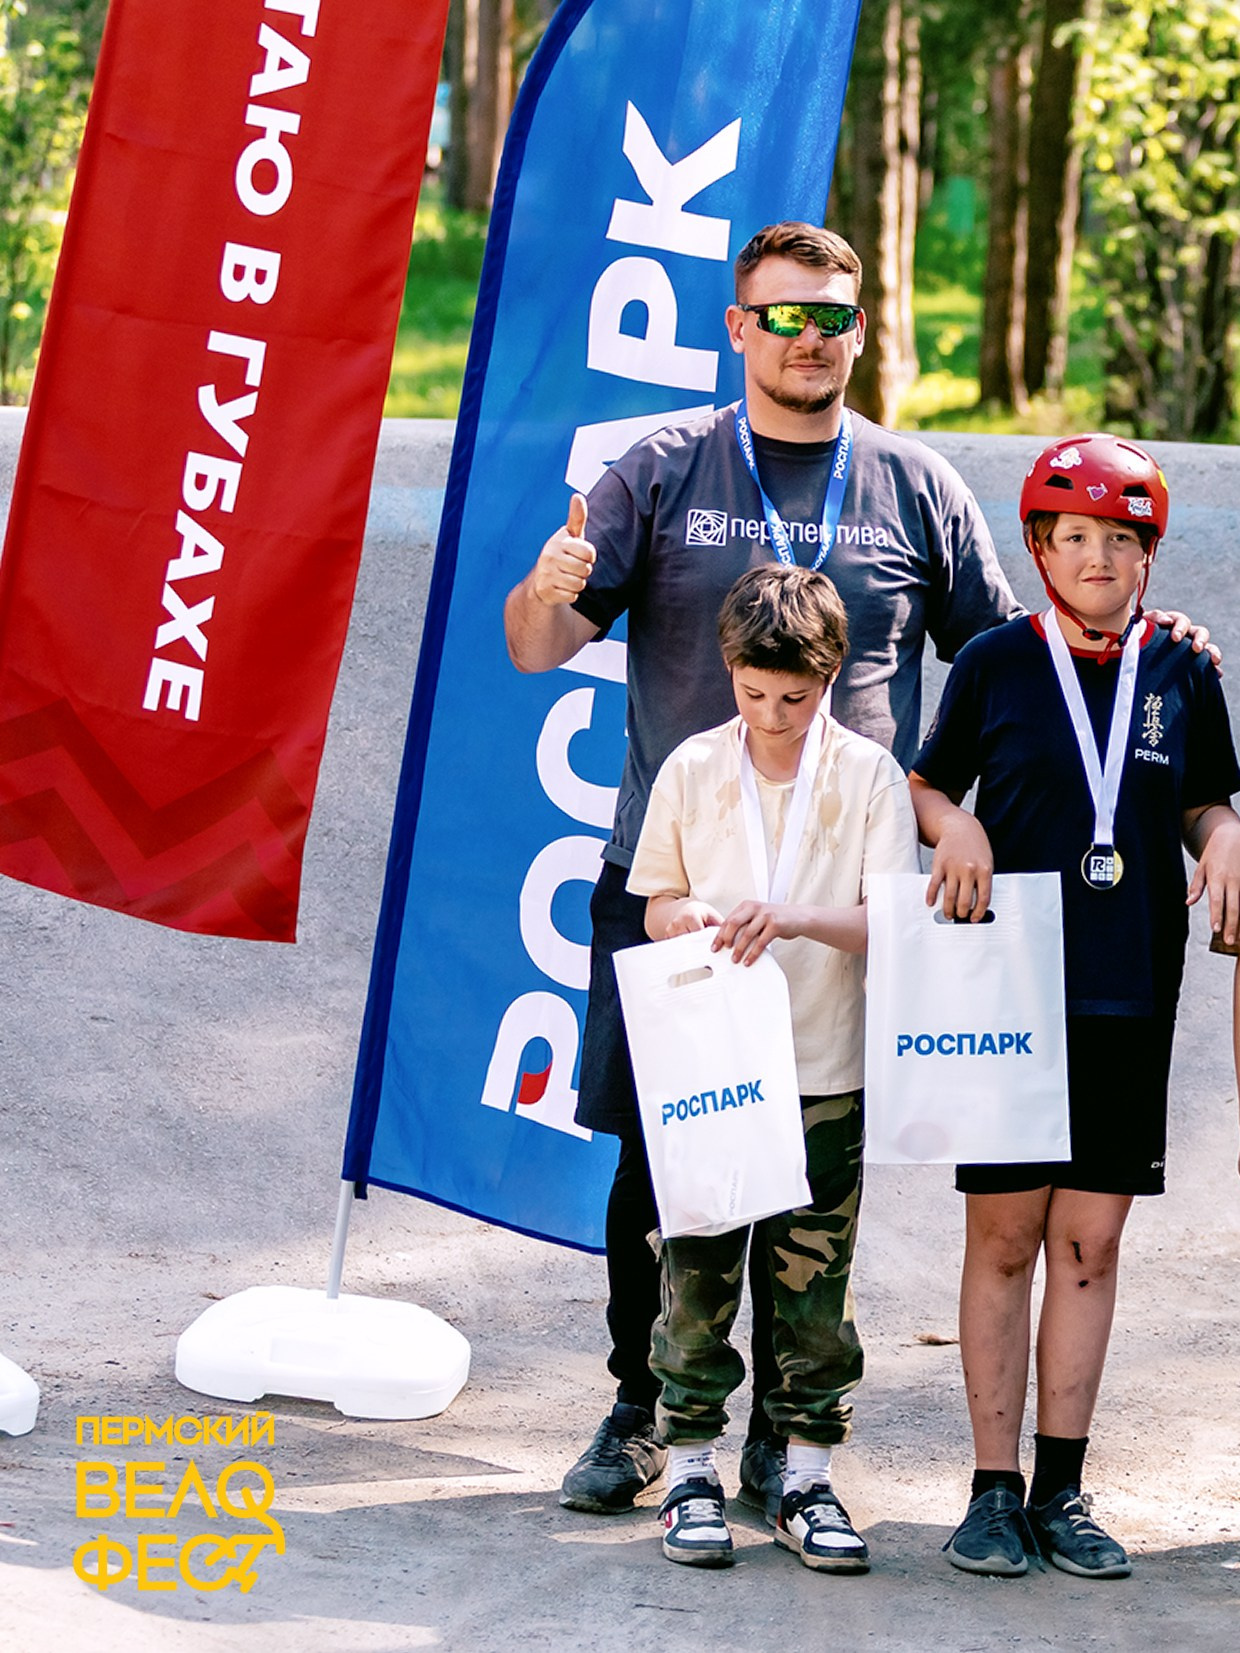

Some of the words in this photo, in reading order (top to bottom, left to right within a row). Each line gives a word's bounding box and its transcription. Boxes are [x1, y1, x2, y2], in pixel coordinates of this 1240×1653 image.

[219, 241, 282, 305] В
[833, 423, 851, 480] РОСПАР
[143, 330, 268, 722] ГУБАХЕ
[730, 517, 890, 548] перпетива
[481, 100, 742, 1142] РОСАРК
[1134, 748, 1170, 766] PERM
[896, 1031, 1034, 1057] РОСПАРК
[661, 1079, 766, 1126] РОСПАРК
